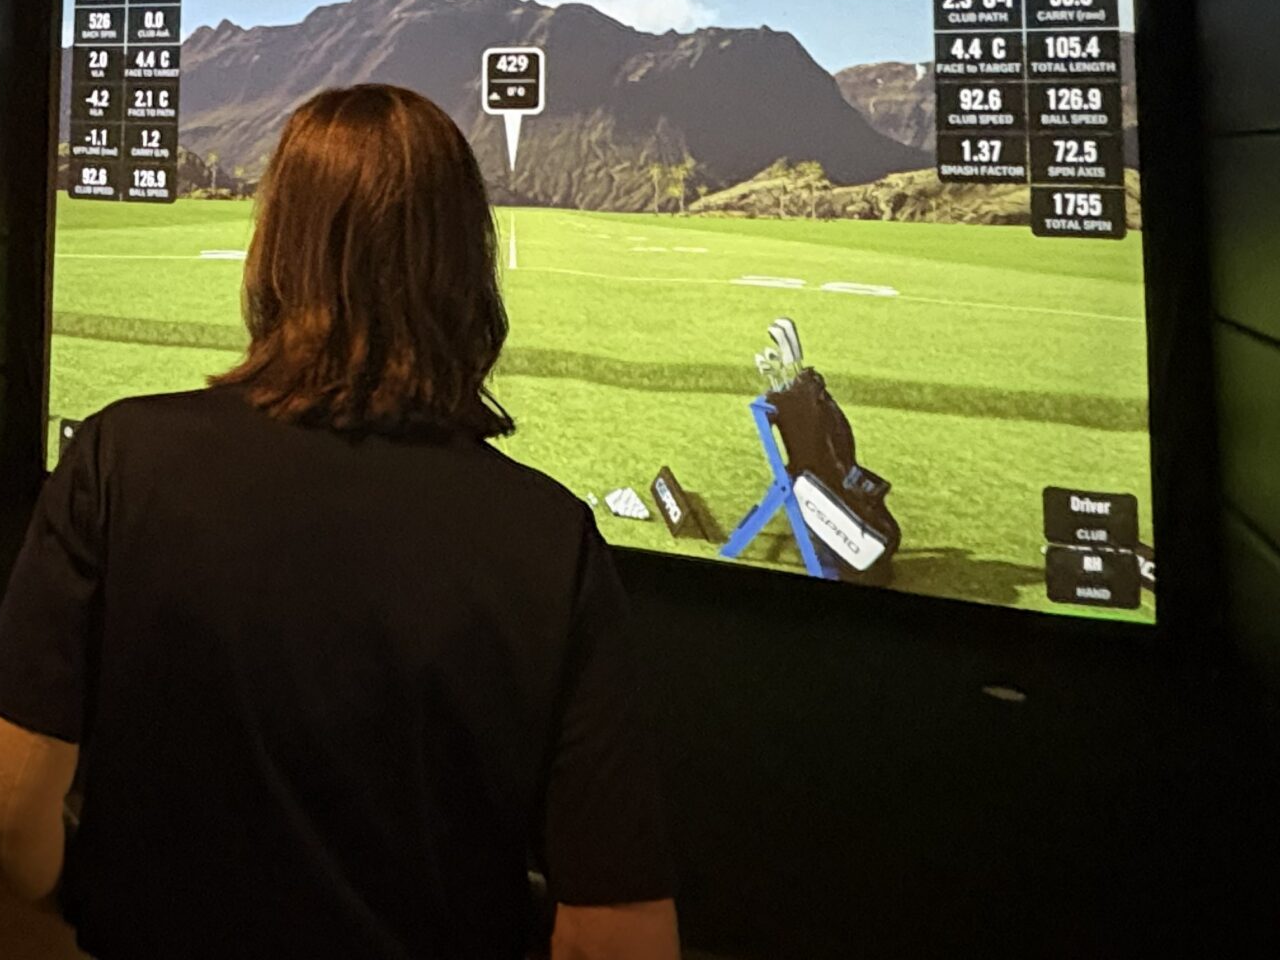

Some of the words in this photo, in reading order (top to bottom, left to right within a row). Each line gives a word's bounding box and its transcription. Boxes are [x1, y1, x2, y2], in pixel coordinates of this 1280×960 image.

[88, 12, 111, 29] 526
[144, 11, 164, 28] 0.0
[948, 13, 977, 23] CLUB
[979, 11, 1009, 22] PATH
[1036, 11, 1073, 22] CARRY
[951, 38, 982, 59] 4.4
[992, 37, 1006, 59] C
[1045, 36, 1101, 59] 105.4
[89, 50, 108, 68] 2.0
[135, 50, 155, 68] 4.4
[160, 50, 170, 68] C
[496, 54, 529, 72] 429
[1031, 62, 1067, 72] TOTAL
[1070, 62, 1116, 73] LENGTH
[937, 63, 964, 73] FACE
[980, 63, 1021, 73] TARGET
[85, 90, 109, 107] -4.2
[135, 90, 153, 108] 2.1
[159, 90, 169, 108] C
[959, 88, 1002, 111] 92.6
[1047, 88, 1102, 111] 126.9
[948, 114, 977, 125] CLUB
[979, 114, 1014, 125] SPEED
[1041, 114, 1069, 125] BALL
[1071, 114, 1108, 125] SPEED
[85, 128, 107, 146] -1.1
[141, 130, 160, 147] 1.2
[961, 140, 1002, 162] 1.37
[1053, 140, 1097, 163] 72.5
[82, 168, 107, 185] 92.6
[133, 169, 166, 188] 126.9
[941, 165, 978, 176] SMASH
[981, 165, 1024, 176] FACTOR
[1048, 166, 1075, 177] SPIN
[1077, 166, 1106, 177] AXIS
[1053, 193, 1102, 216] 1755
[1045, 218, 1081, 230] TOTAL
[1083, 220, 1112, 231] SPIN
[1070, 495, 1111, 515] Driver
[1076, 528, 1107, 542] CLUB
